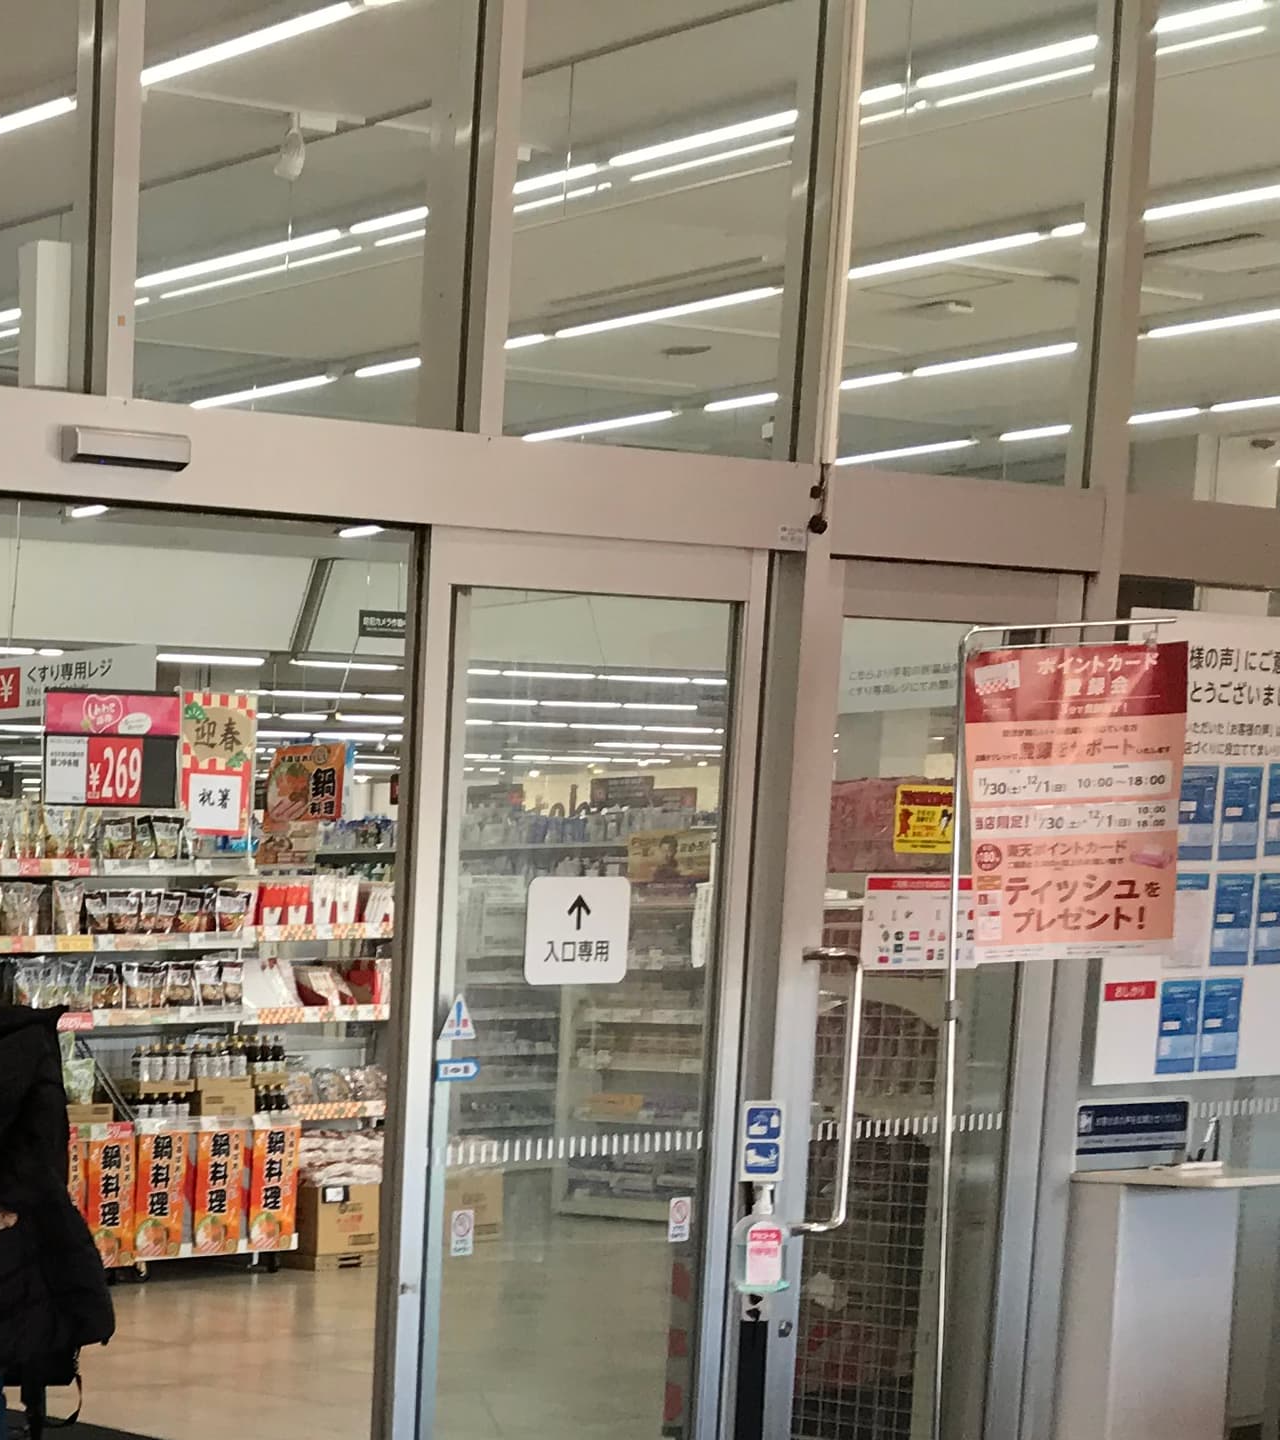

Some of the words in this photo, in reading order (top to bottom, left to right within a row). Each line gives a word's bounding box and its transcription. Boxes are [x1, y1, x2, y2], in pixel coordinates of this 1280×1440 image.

[25, 658, 113, 684] くすり専用レジ
[1036, 651, 1160, 676] ポイントカード
[1063, 675, 1130, 697] 登録会
[193, 716, 243, 753] 迎春
[101, 746, 143, 799] 269
[310, 766, 337, 799] 鍋
[309, 800, 336, 817] 料理
[1005, 873, 1162, 906] ティッシュを
[1013, 905, 1146, 934] プレゼント!
[543, 939, 610, 964] 入口専用
[100, 1144, 122, 1228] 鍋料理
[148, 1135, 173, 1217] 鍋料理
[207, 1133, 231, 1214] 鍋料理
[262, 1130, 286, 1211] 鍋料理
